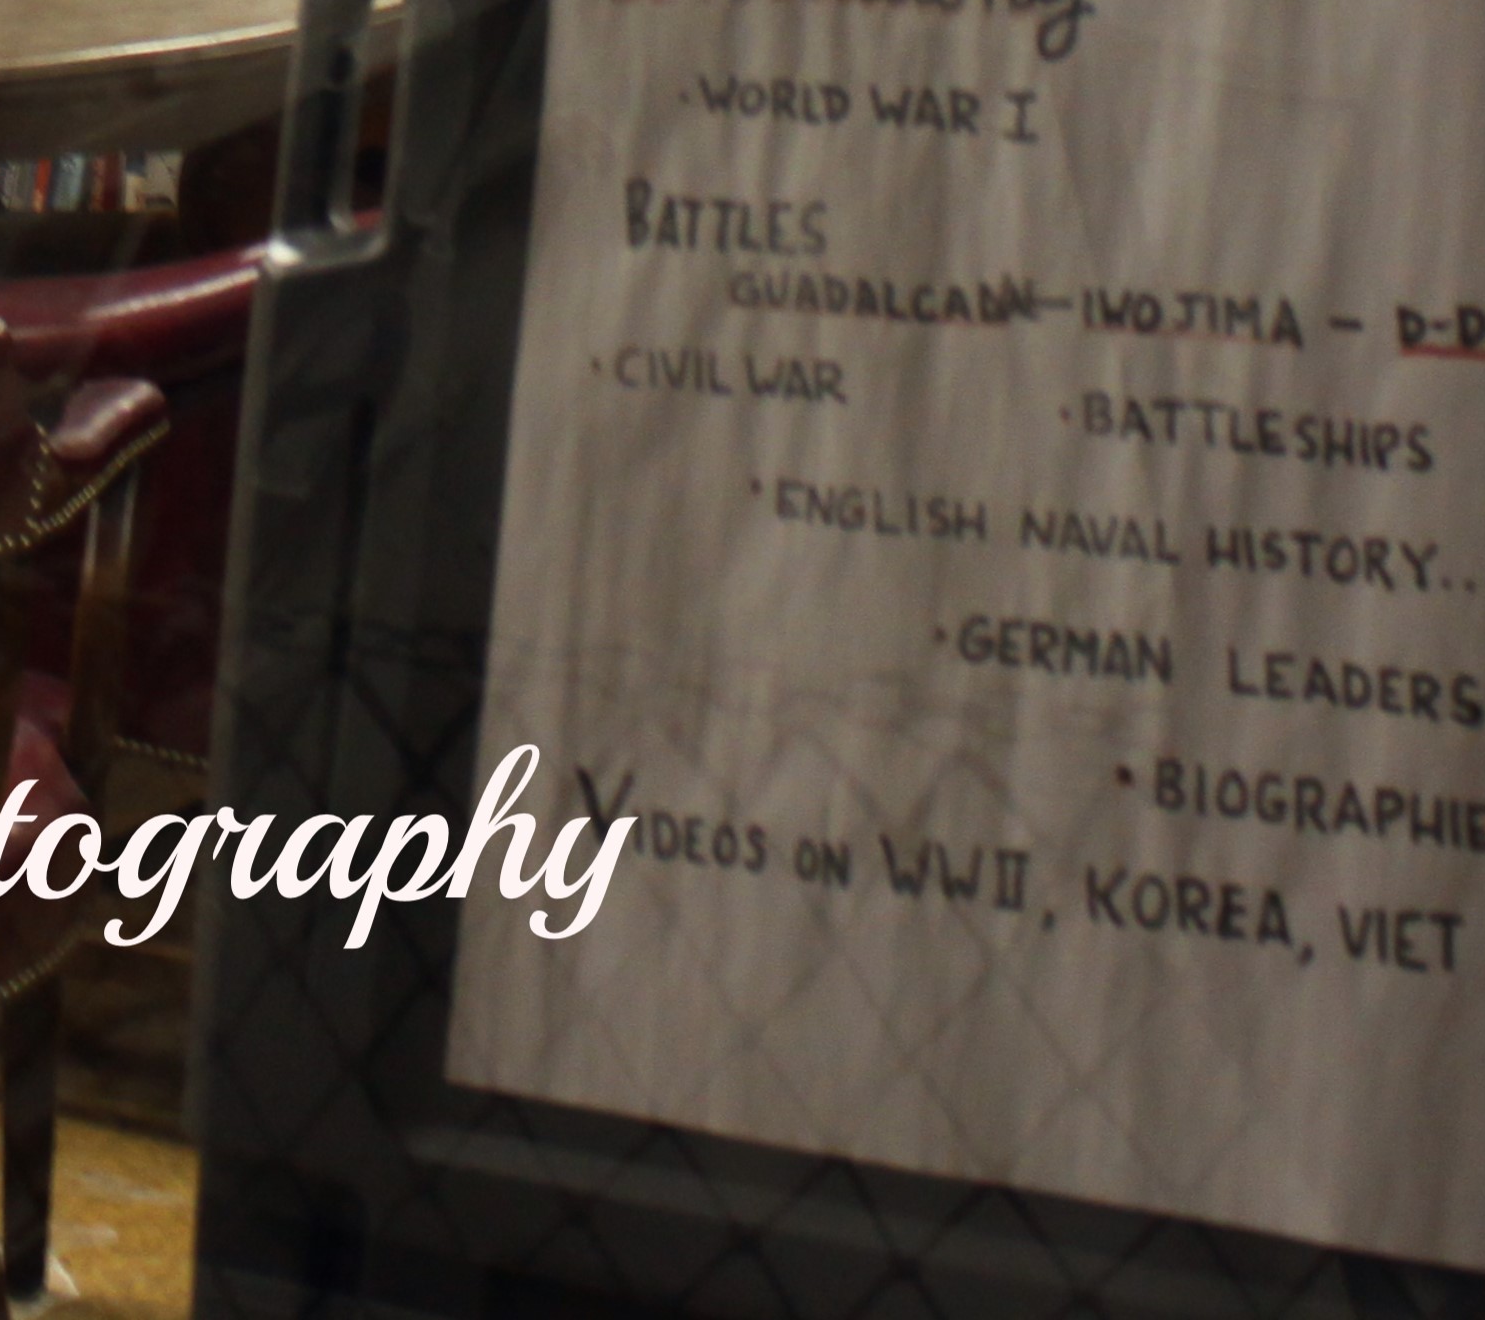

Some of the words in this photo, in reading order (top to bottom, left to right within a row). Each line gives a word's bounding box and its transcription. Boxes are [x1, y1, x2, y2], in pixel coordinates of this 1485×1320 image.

[698, 74, 851, 127] WORLD
[869, 83, 981, 135] WAR
[1003, 89, 1039, 144] I
[624, 176, 827, 257] BATTLES
[614, 344, 732, 397] CIVIL
[742, 351, 848, 406] WAR
[1082, 387, 1434, 474] BATTLESHIPS
[776, 477, 988, 542] ENGLISH
[1020, 505, 1180, 567] NAVAL
[957, 613, 1174, 683] GERMAN
[1228, 646, 1485, 730] LEADERS
[794, 837, 852, 887] ON
[1087, 864, 1314, 968] KOREA,
[1338, 904, 1463, 974] VIET
